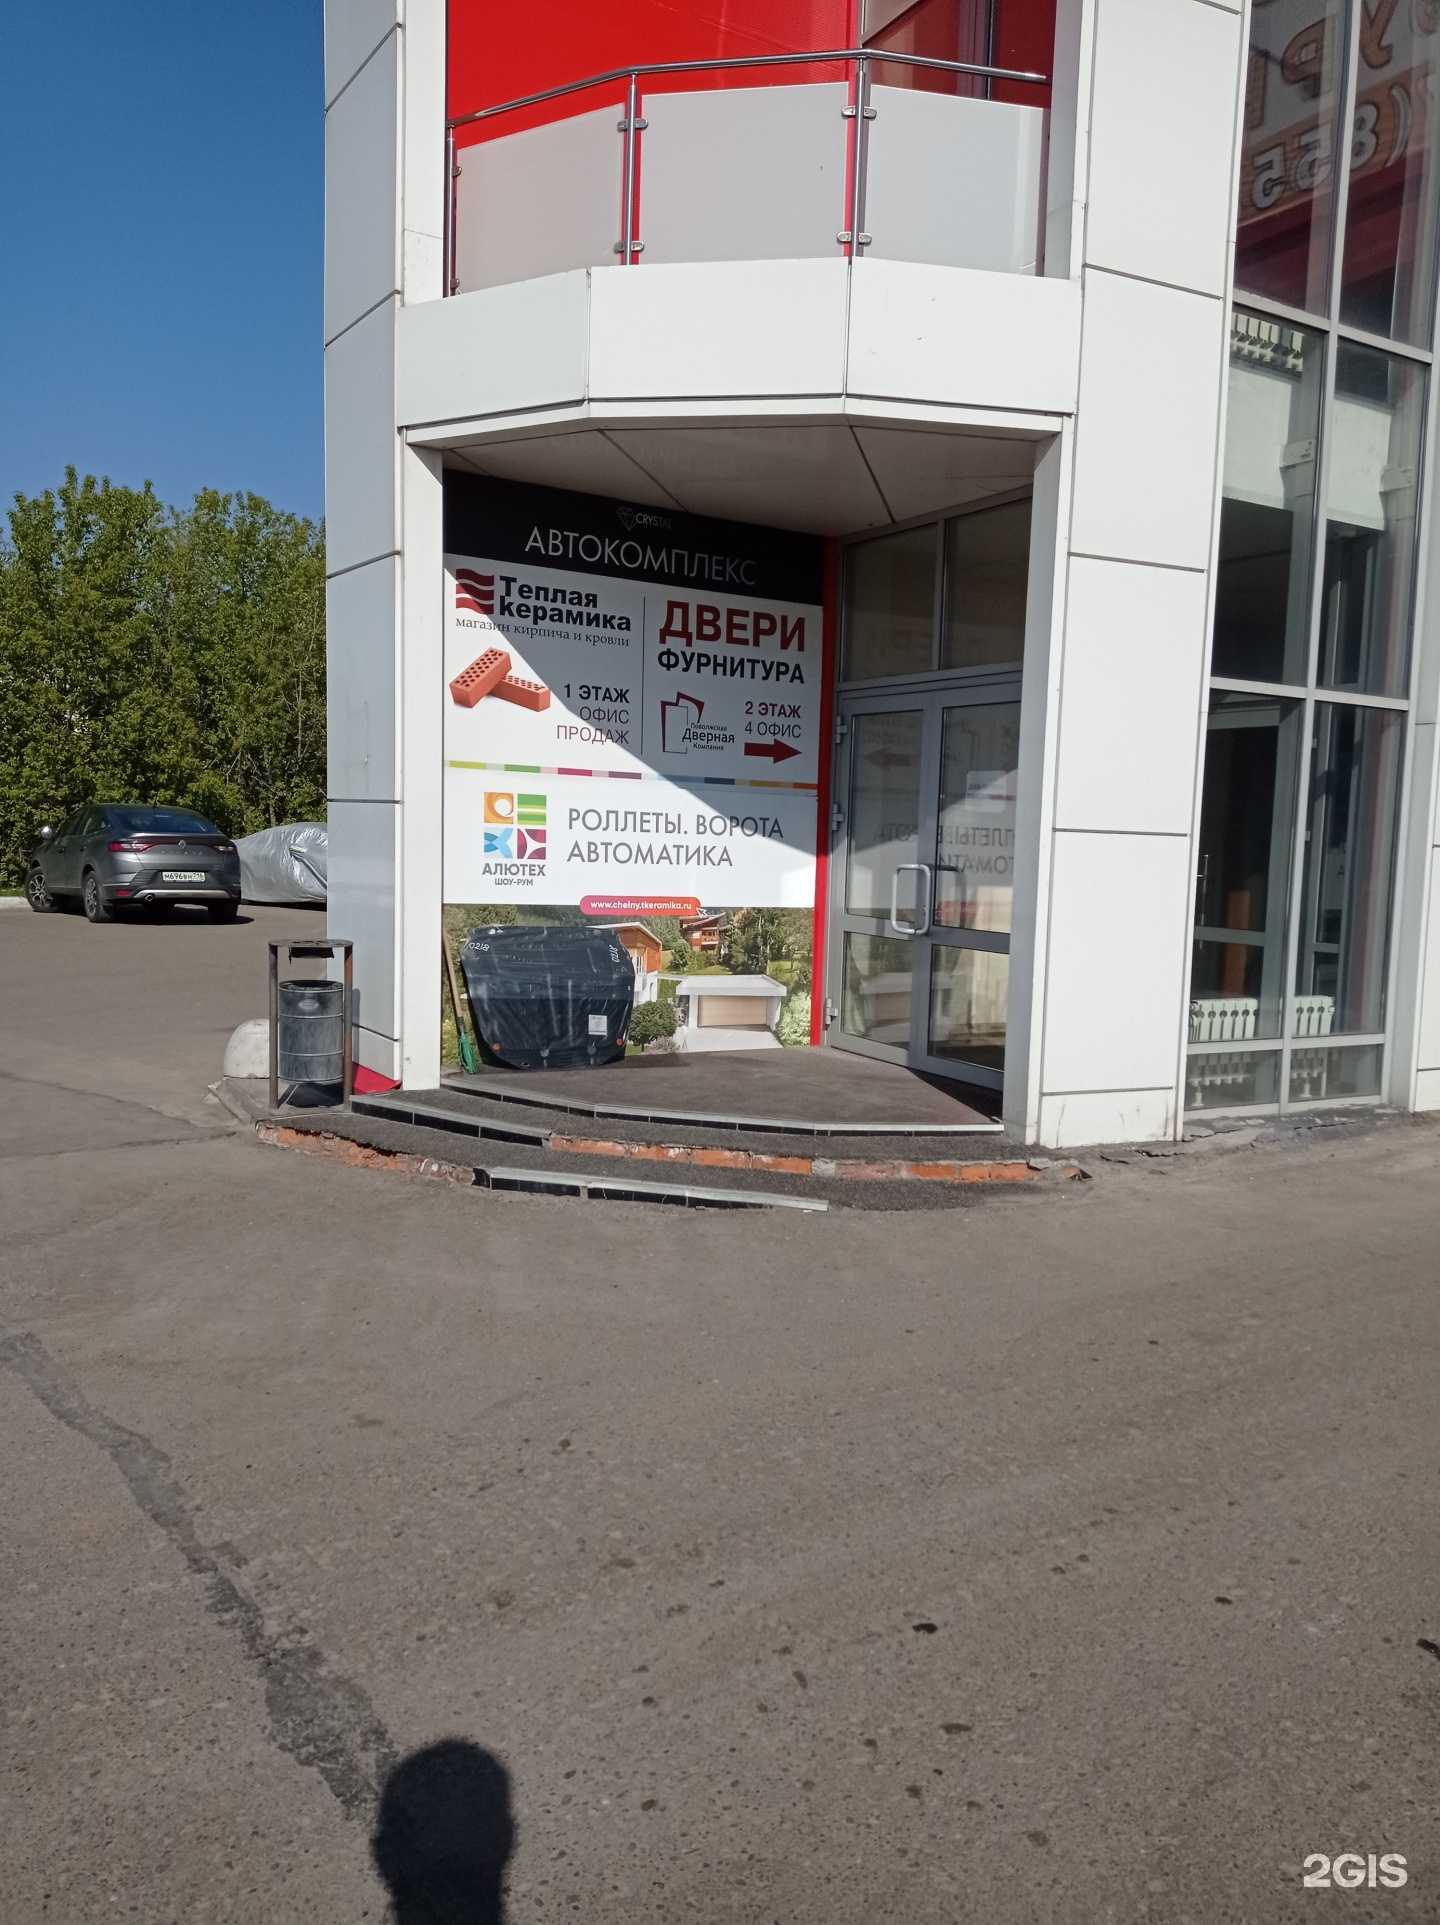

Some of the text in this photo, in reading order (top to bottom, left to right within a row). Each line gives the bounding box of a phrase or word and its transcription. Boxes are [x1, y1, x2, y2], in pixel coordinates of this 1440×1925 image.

[525, 525, 757, 585] АВТОКОМПЛЕКС
[499, 575, 598, 609] Теплая
[499, 595, 632, 632] керамика
[456, 617, 630, 647] магазин кирпича и кровли
[659, 599, 805, 652] ДВЕРИ
[657, 648, 805, 684] ФУРНИТУРА
[564, 685, 630, 703] 1 ЭТАЖ
[580, 706, 630, 725] ОФИС
[744, 701, 801, 719] 2 ЭТАЖ
[557, 725, 630, 744] ПРОДАЖ
[682, 728, 735, 744] Дверная
[744, 722, 802, 739] 4 ОФИС
[693, 742, 724, 751] Компания
[568, 808, 785, 839] РОЛЛЕТЫ. ВОРОТА
[567, 839, 734, 867] АВТОМАТИКА
[482, 862, 546, 877] АЛЮТЕХ
[494, 877, 534, 887] ШОУ-РУМ
[590, 900, 691, 911] www.chelny.tkeramika.ru
